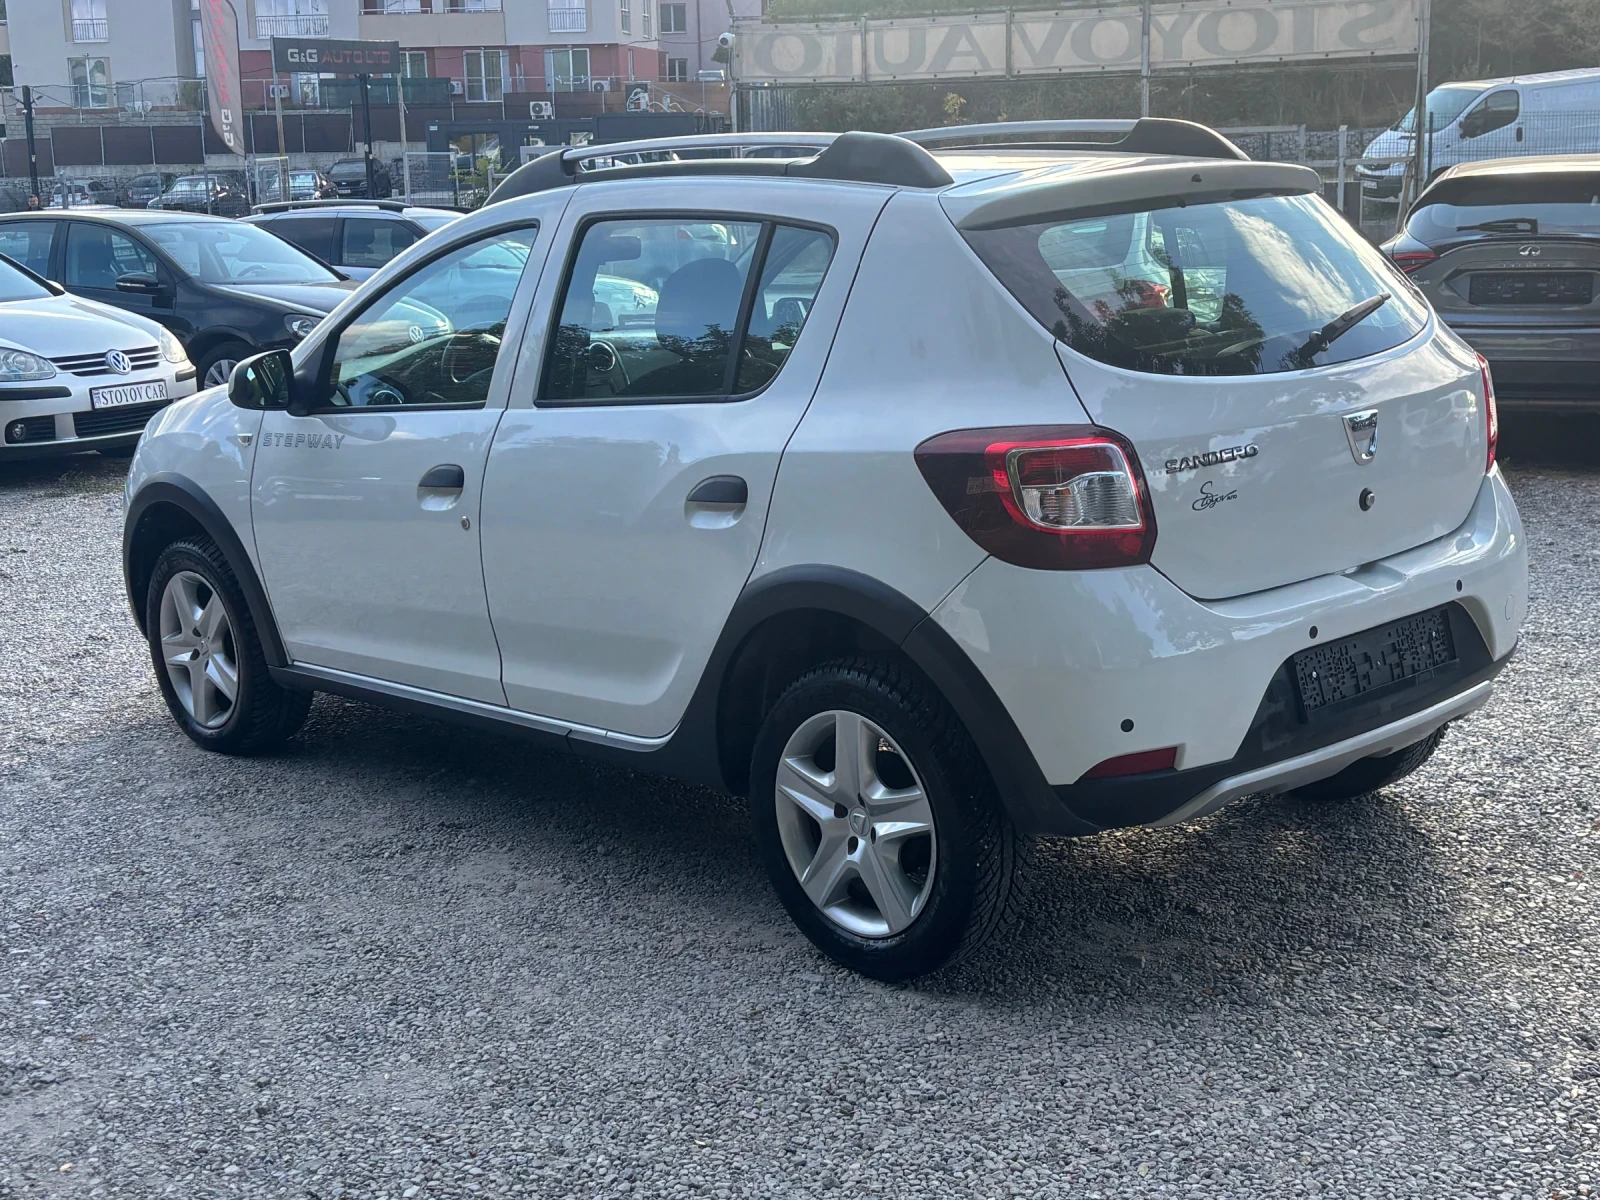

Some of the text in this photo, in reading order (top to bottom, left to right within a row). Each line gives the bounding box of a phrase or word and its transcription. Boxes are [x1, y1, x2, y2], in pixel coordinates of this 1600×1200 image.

[287, 48, 391, 64] G&G AUTO LTD
[101, 386, 143, 406] STOYOV
[145, 384, 166, 400] CAR
[262, 432, 346, 449] STEPWAY
[1165, 443, 1259, 474] SANDERO
